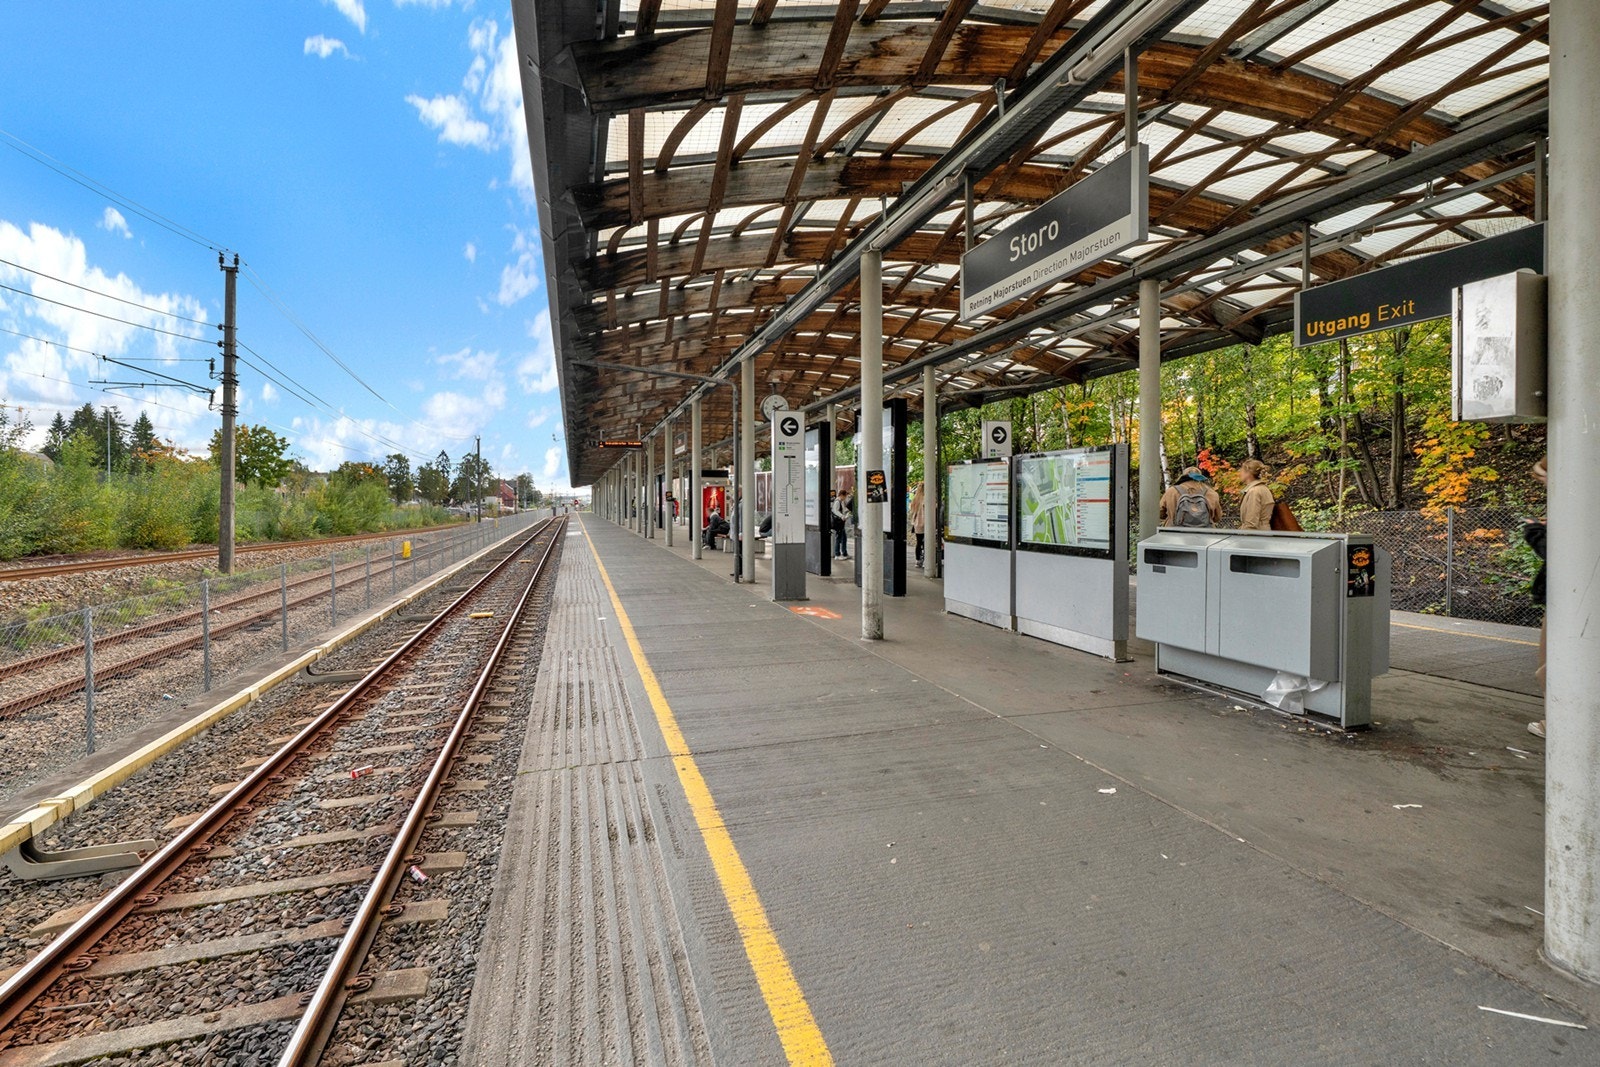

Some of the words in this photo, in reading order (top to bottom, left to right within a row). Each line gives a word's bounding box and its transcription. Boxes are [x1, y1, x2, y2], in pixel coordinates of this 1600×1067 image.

[1009, 220, 1059, 262] Storo
[969, 295, 992, 312] Retning
[993, 275, 1032, 301] Majorstuen
[1033, 258, 1068, 281] Direction
[1069, 231, 1121, 264] Majorstuen
[1306, 312, 1370, 337] Utgang
[1378, 299, 1415, 322] Exit
